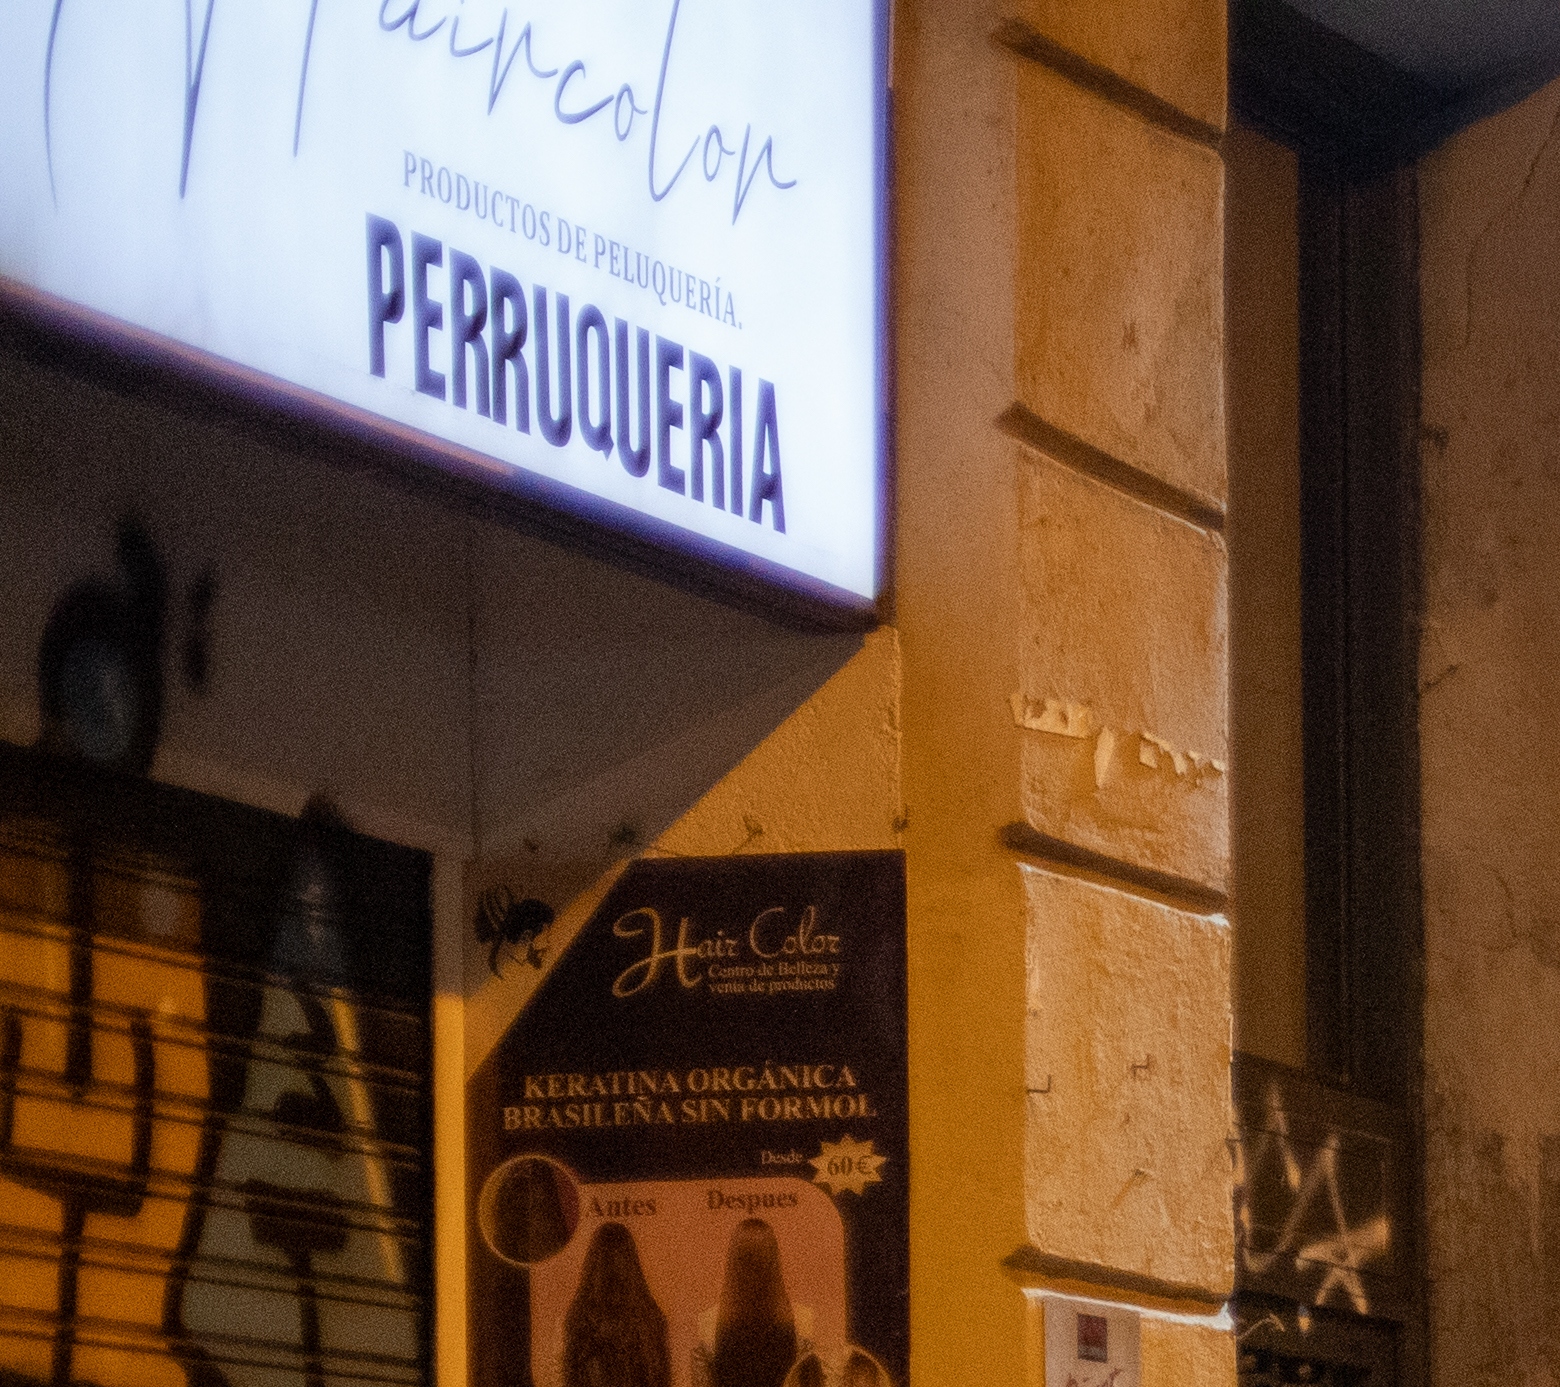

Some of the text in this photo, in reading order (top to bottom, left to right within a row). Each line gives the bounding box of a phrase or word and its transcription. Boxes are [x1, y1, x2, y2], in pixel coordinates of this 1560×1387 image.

[402, 149, 551, 247] PRODUCTOS
[557, 216, 588, 264] DE
[365, 211, 787, 536] PERRUQUERIA
[611, 904, 841, 998] Hair Color
[523, 1060, 858, 1099] KERATINA ORGÁNICA
[503, 1094, 877, 1131] BRASILEÑA SIN FORMOL
[761, 1149, 803, 1166] Desde
[587, 1196, 657, 1218] Antes
